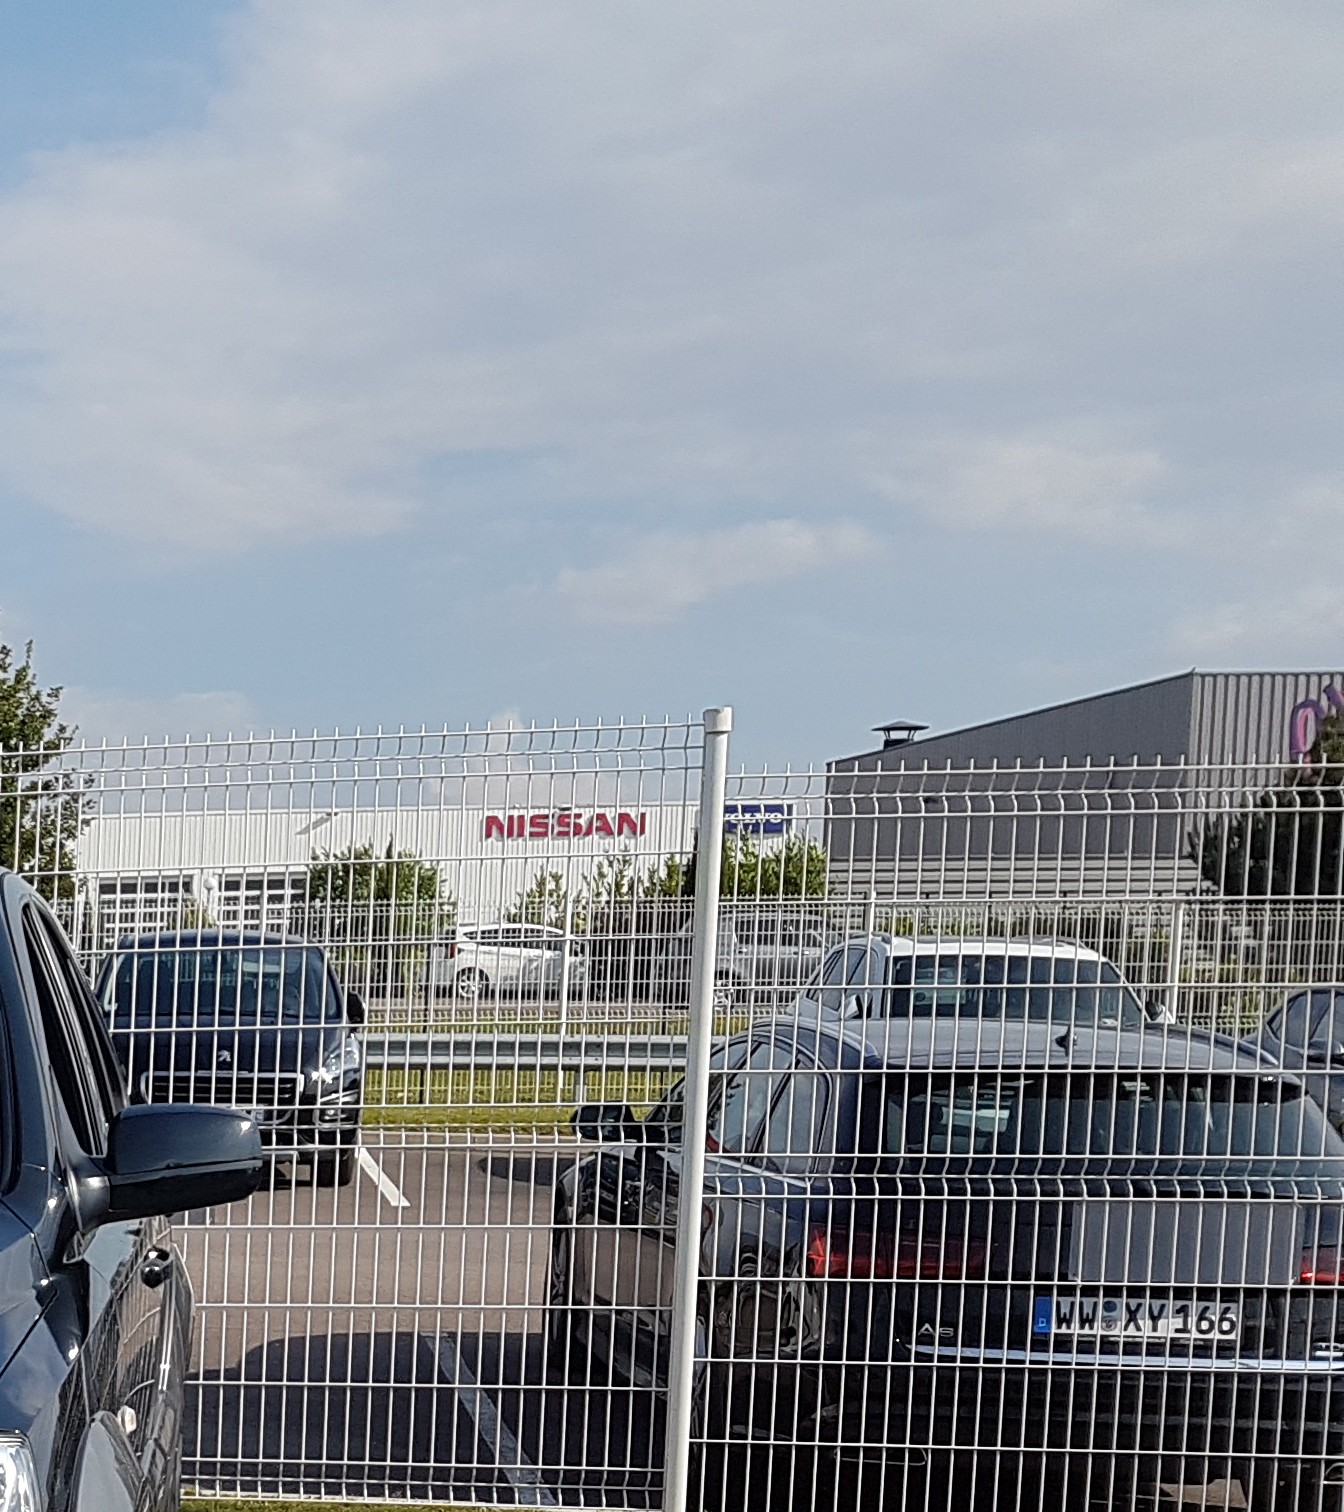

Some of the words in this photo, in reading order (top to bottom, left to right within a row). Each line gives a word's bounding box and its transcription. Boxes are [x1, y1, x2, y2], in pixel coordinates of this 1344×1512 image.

[484, 812, 647, 840] NISSAN
[1055, 1301, 1098, 1331] WW
[1123, 1302, 1166, 1332] XY
[1174, 1304, 1237, 1336] 166
